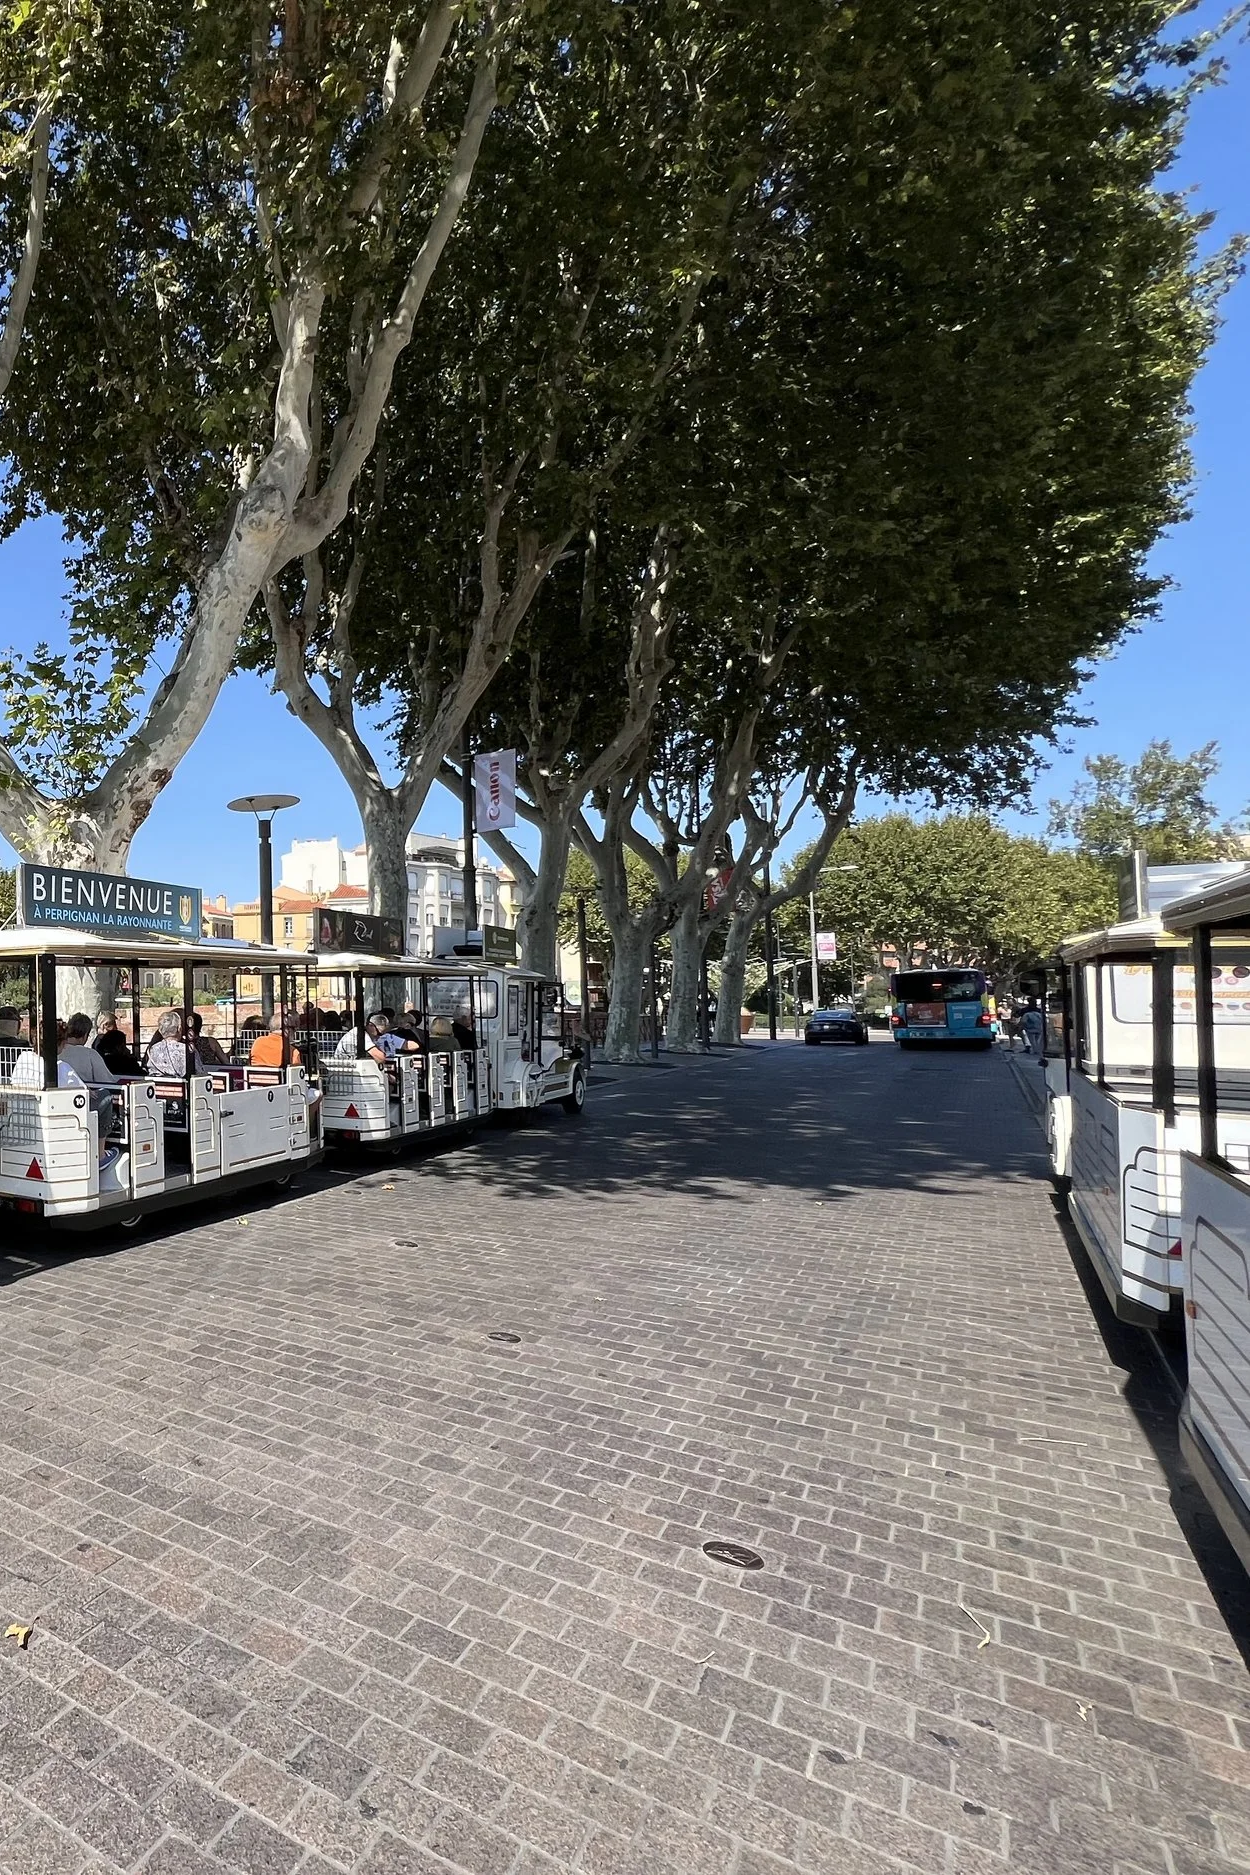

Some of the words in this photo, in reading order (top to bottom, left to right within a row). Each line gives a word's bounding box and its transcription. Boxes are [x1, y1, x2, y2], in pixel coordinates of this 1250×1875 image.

[489, 761, 500, 821] Canon
[32, 872, 173, 916] BIENVENUE
[33, 903, 42, 918] À
[45, 907, 100, 924] PERPIGNAN
[102, 915, 115, 925] LA
[117, 916, 172, 931] RAYONNANTE
[75, 1097, 85, 1106] 10
